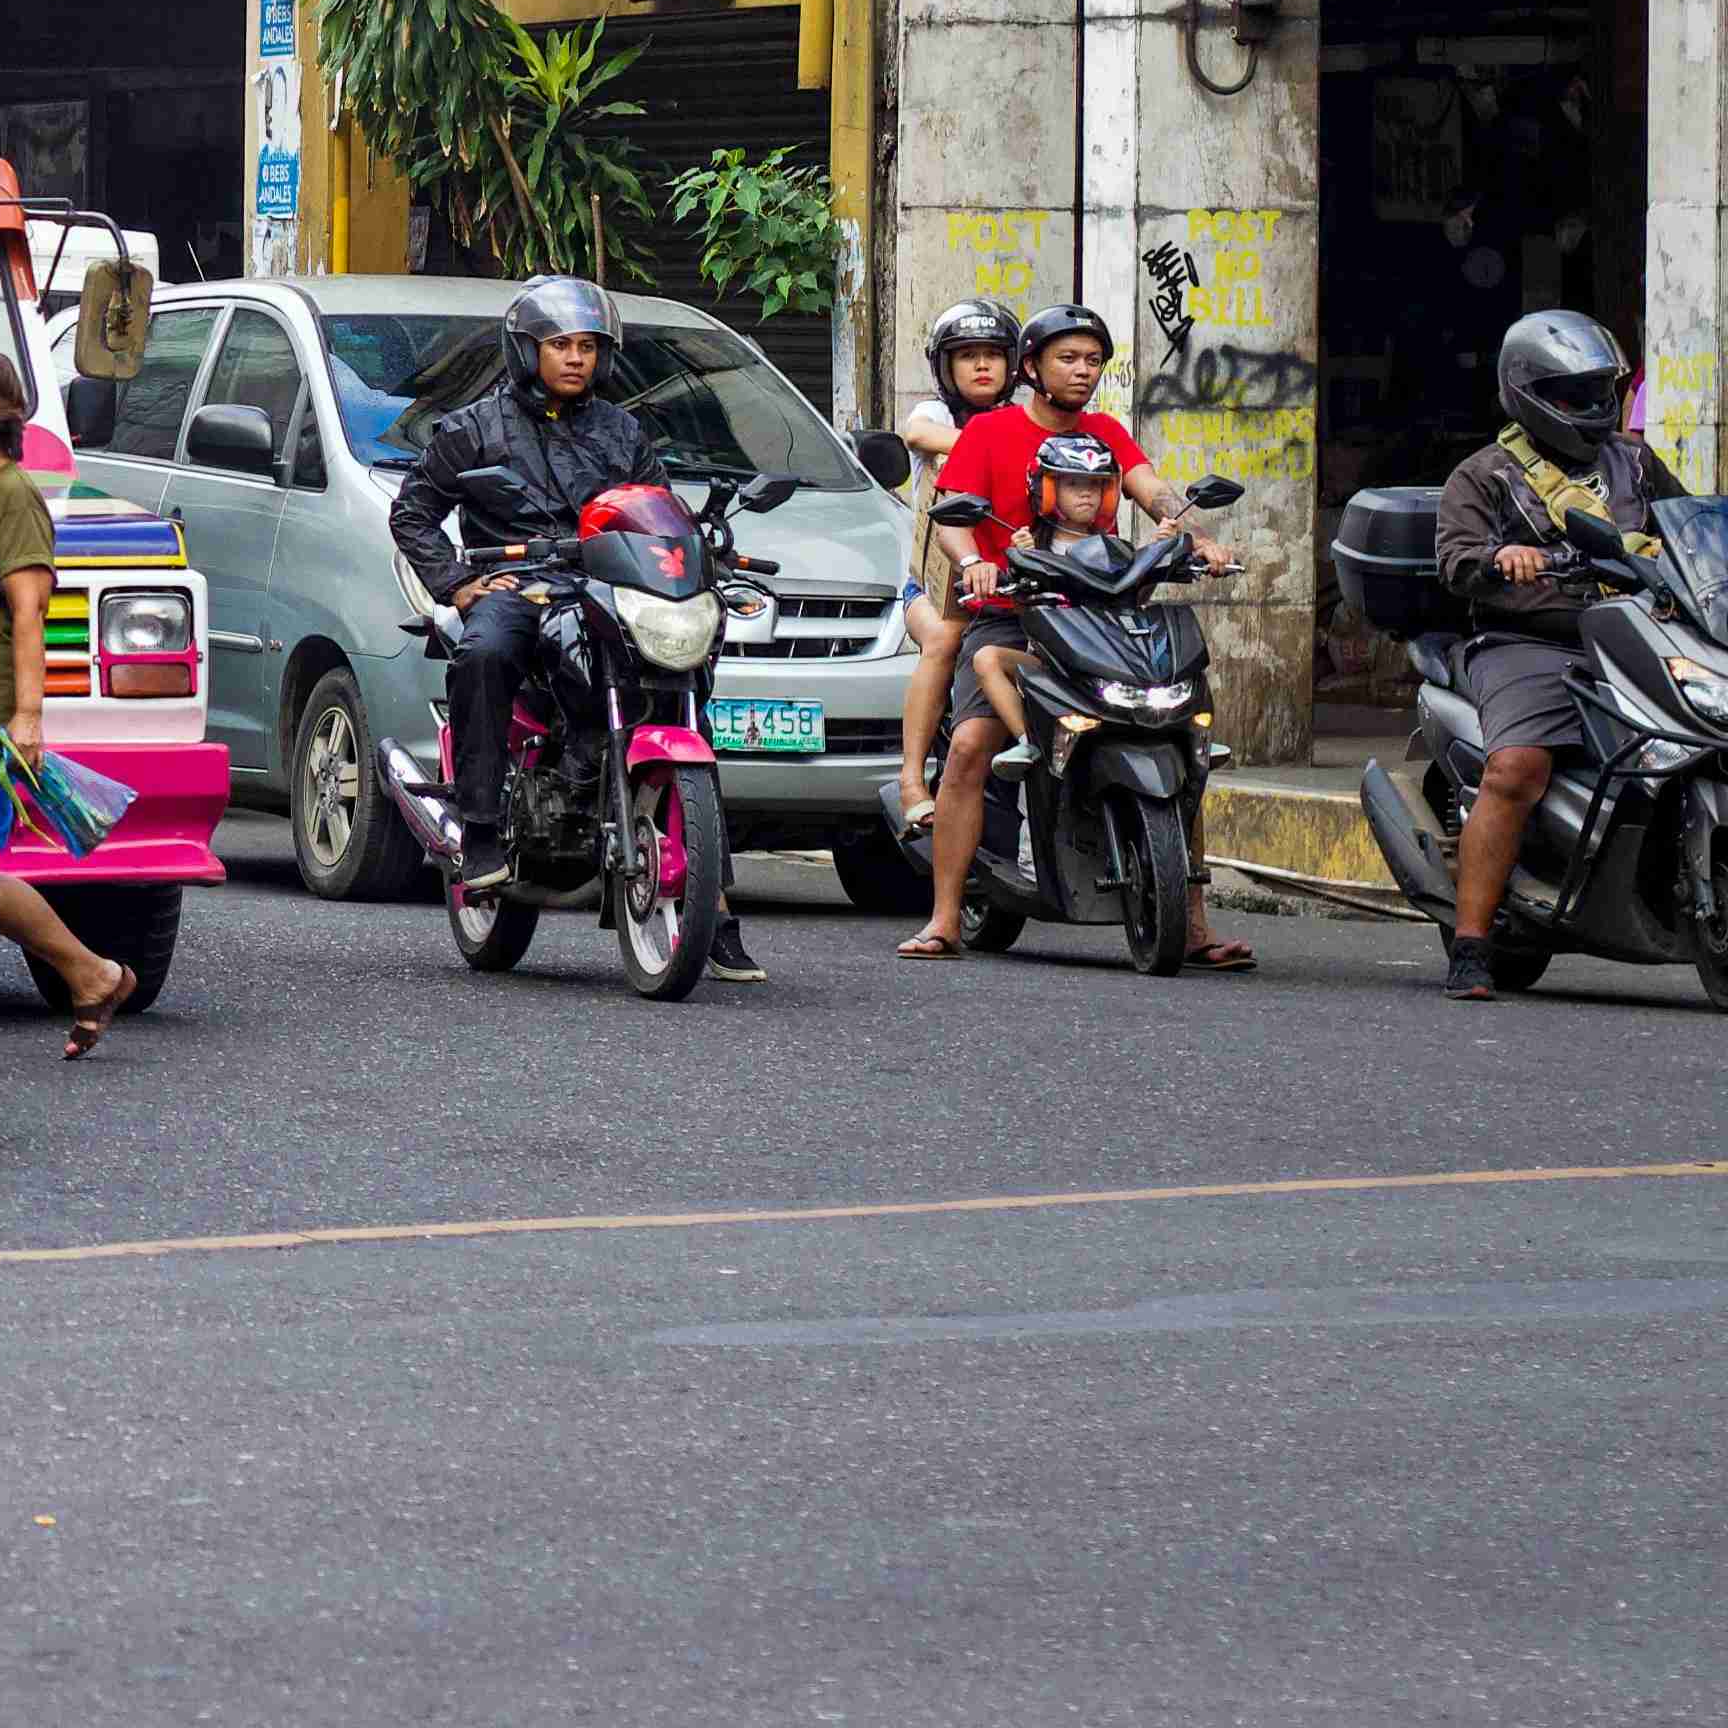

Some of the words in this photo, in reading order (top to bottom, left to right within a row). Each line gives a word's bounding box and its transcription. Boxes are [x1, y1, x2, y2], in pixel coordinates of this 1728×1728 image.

[263, 25, 294, 44] ANDALES
[270, 163, 289, 178] BEBS
[259, 185, 291, 204] ANDALES
[948, 210, 1050, 252] POST
[1187, 209, 1281, 242] POST
[975, 263, 1035, 296] NO
[1214, 250, 1263, 283] NO
[1186, 286, 1273, 326] BILL
[763, 706, 813, 735] 458
